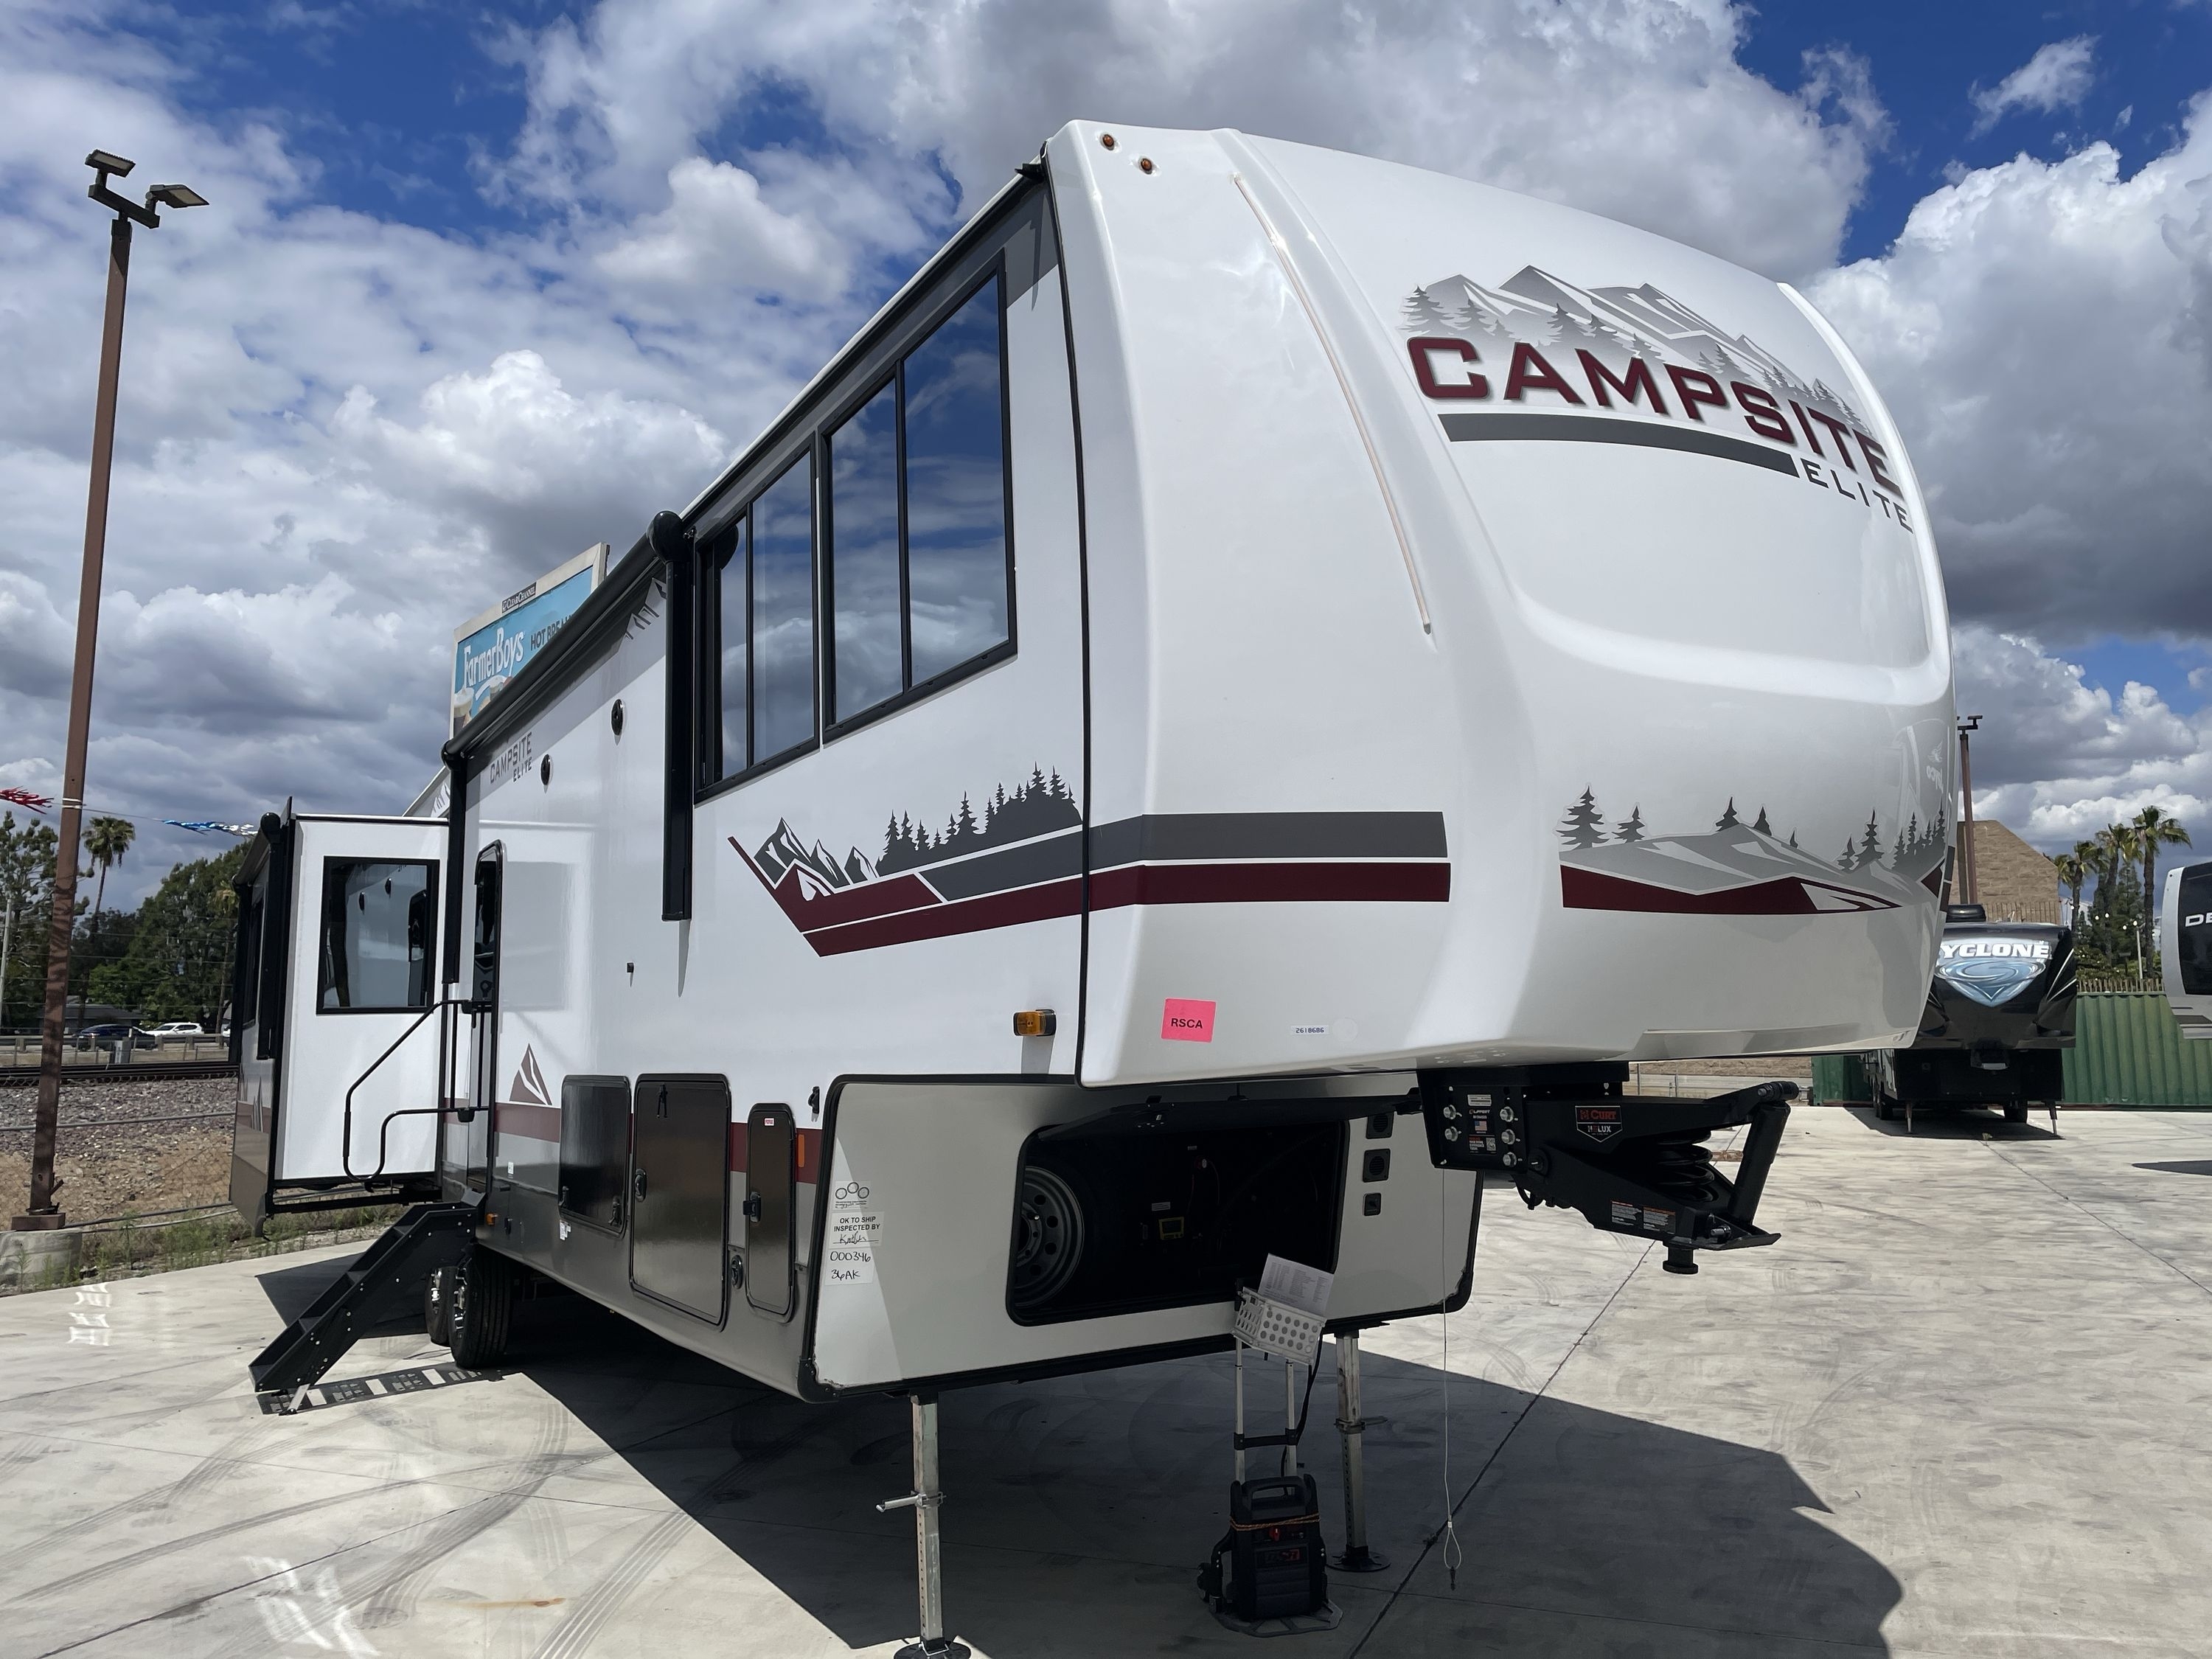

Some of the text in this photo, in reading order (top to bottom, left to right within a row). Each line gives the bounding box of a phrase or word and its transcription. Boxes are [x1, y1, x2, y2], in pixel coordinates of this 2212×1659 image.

[1407, 335, 1903, 497] CAMPSITE
[1800, 457, 1913, 534] ELITE
[530, 628, 546, 651] HOT
[490, 731, 532, 785] CAMPSITE
[512, 756, 532, 783] ELITE
[1940, 943, 2050, 959] YCLONE
[1170, 1018, 1203, 1029] RSCA
[834, 1224, 870, 1232] INSPECTED
